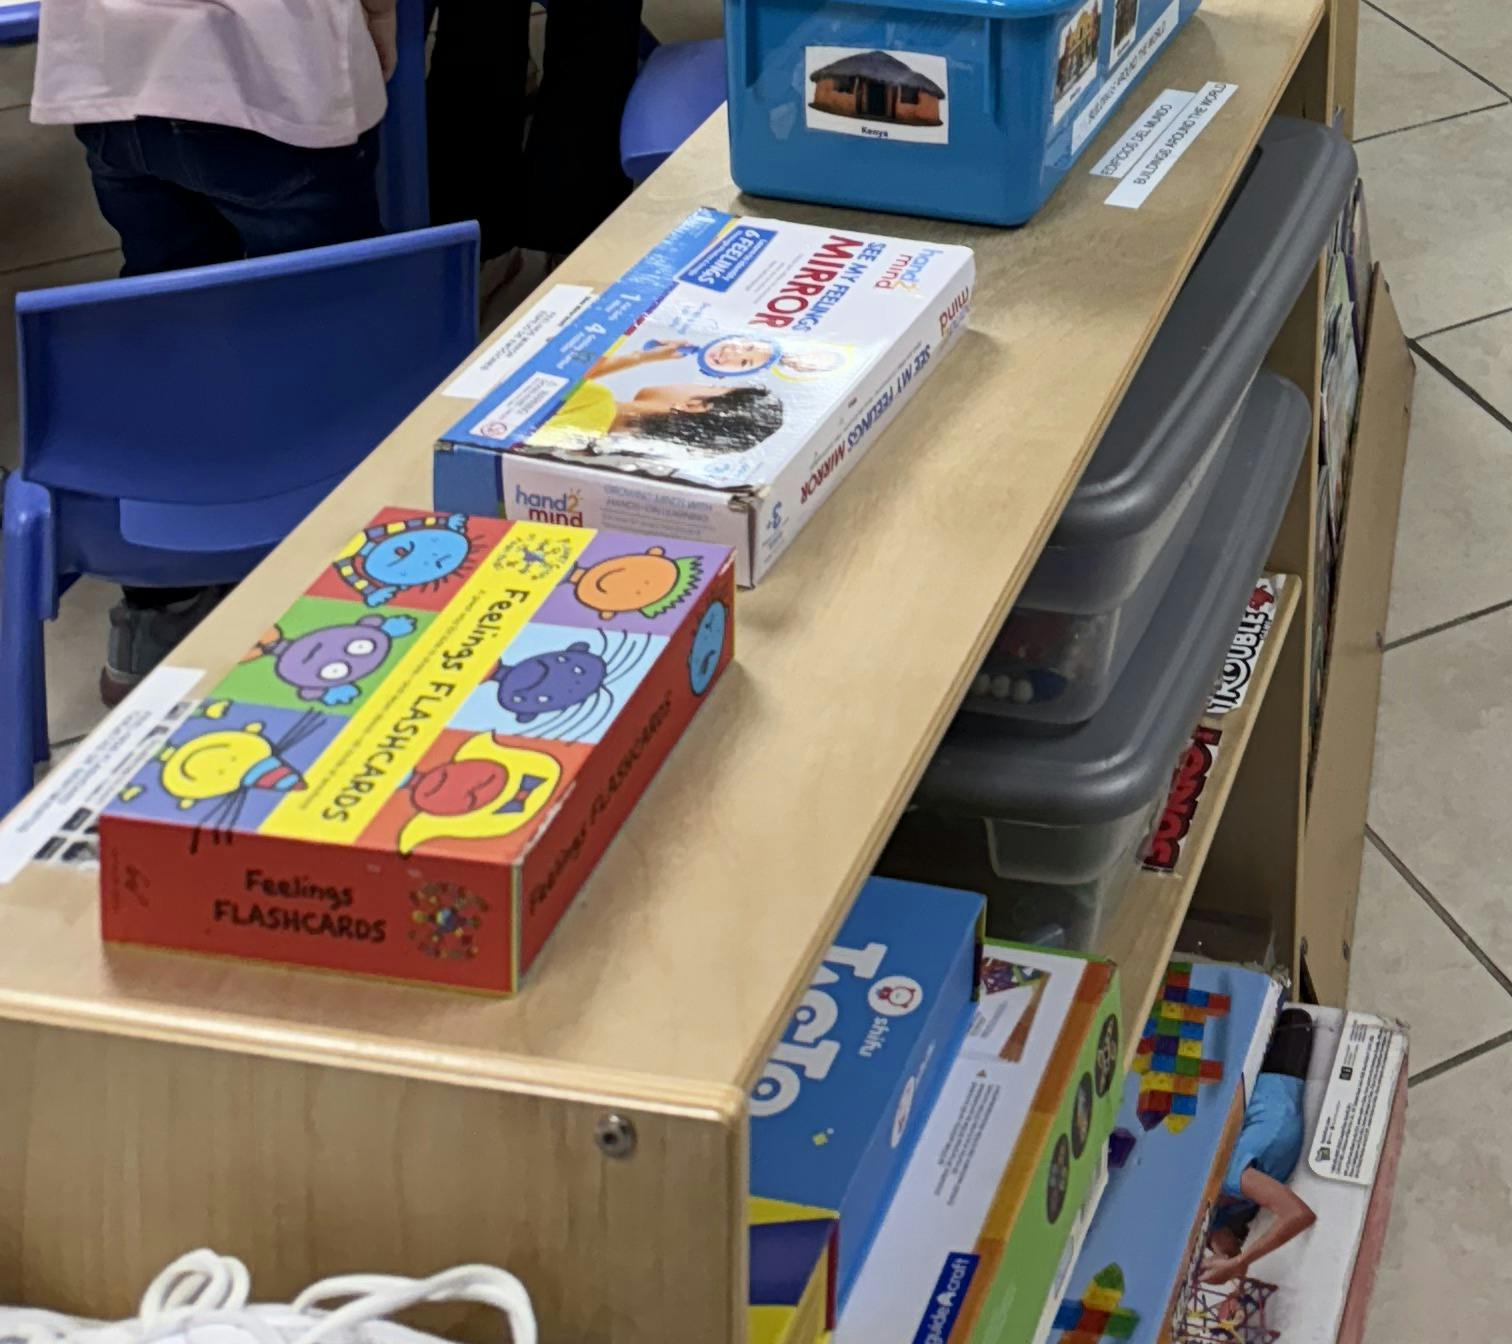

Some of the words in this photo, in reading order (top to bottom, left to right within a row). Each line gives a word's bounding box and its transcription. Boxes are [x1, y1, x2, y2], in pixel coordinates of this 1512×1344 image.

[862, 127, 888, 138] Kenya
[1100, 138, 1139, 176] EDIFICIOS
[1131, 124, 1151, 144] DEL
[1146, 103, 1173, 130] MUNDO
[1133, 148, 1172, 185] BUILDINGS
[1168, 119, 1196, 149] AROUND
[1189, 105, 1208, 126] THE
[1200, 83, 1227, 109] WORLD
[697, 235, 753, 285] FEELINGS
[845, 260, 869, 284] MY
[862, 241, 887, 269] SEE
[874, 253, 914, 291] mind
[748, 234, 864, 330] MIRROR
[791, 282, 850, 333] FEELINGS
[939, 287, 971, 337] mind
[896, 366, 914, 396] MY
[913, 344, 932, 370] SEE
[847, 388, 894, 454] FEELINGS
[800, 439, 847, 505] MIRROR
[516, 484, 583, 513] hand2
[528, 507, 583, 528] mind
[441, 587, 530, 672] Feelings
[1206, 610, 1269, 713] TROUBLE
[321, 680, 456, 822] FLASHCARDS
[529, 826, 585, 917] Feelings
[588, 692, 675, 818] FLASHCARDS
[244, 867, 354, 905] Feelings
[213, 899, 388, 943] FLASHCARDS
[857, 1015, 889, 1058] shifu
